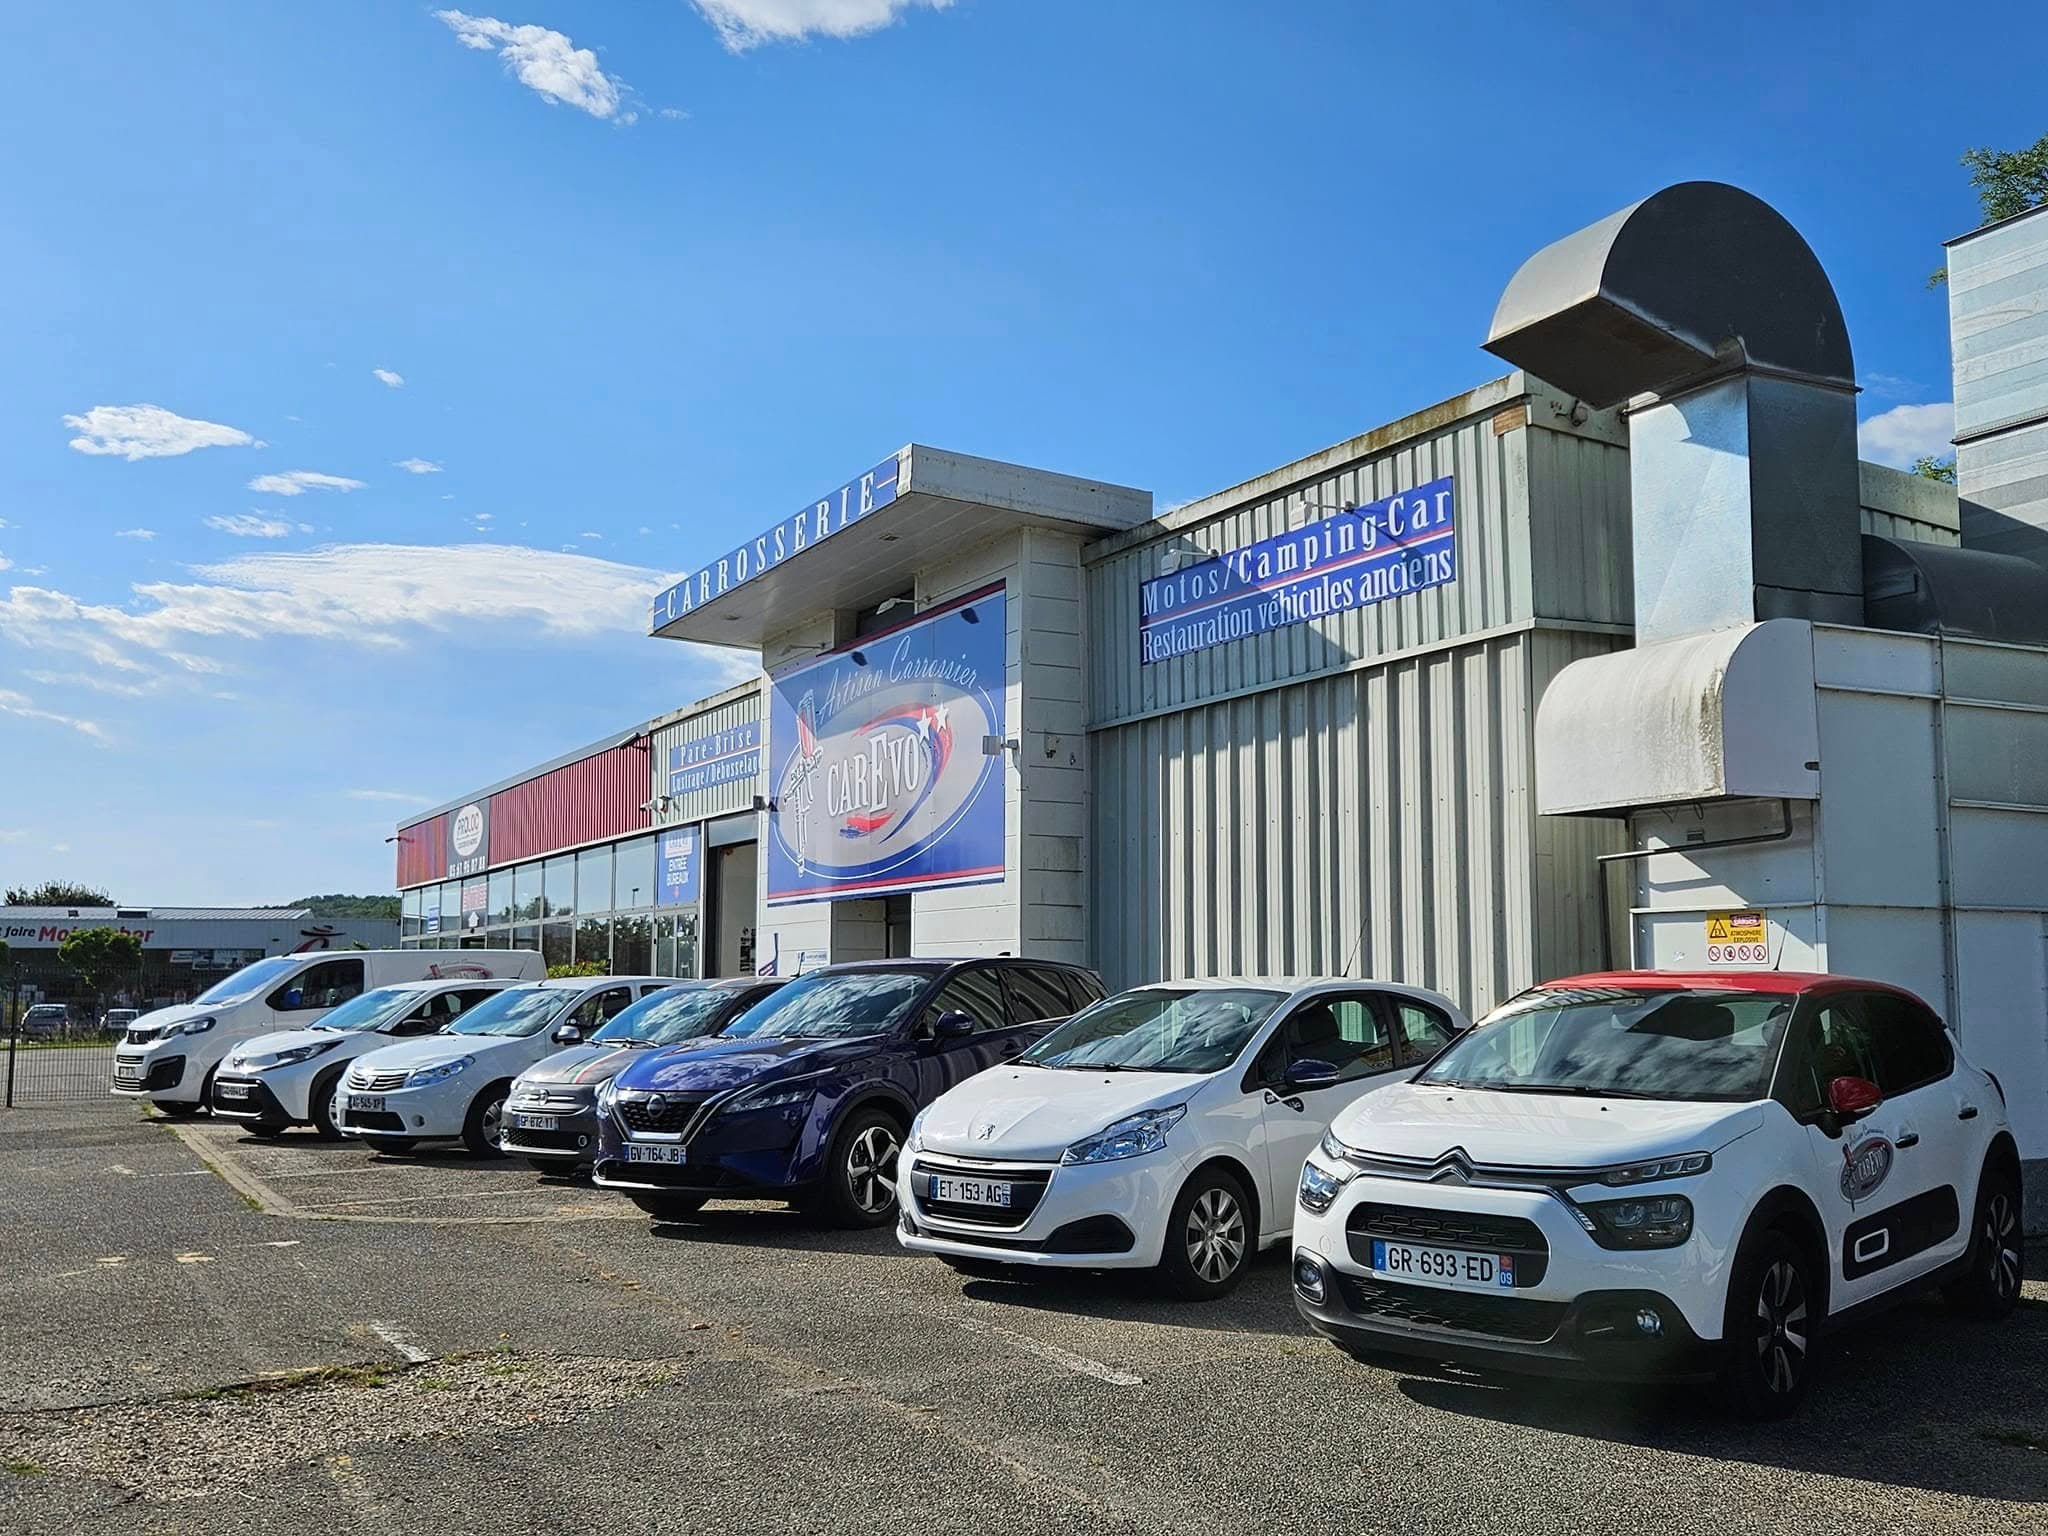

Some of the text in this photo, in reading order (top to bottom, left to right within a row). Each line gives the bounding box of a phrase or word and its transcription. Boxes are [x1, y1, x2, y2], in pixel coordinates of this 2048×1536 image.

[667, 472, 875, 619] CARROSSERIE
[1142, 491, 1450, 617] Motos/Camping-Car
[1143, 547, 1453, 663] Restauration véhicules anciens
[817, 635, 978, 727] Artisan Carrossier
[681, 729, 752, 766] Pare-Brise
[4, 926, 36, 938] faire
[630, 1146, 679, 1162] GV-764-JB
[939, 1180, 1002, 1203] ET-153-AG
[1388, 1247, 1493, 1282] GR-693-ED
[1500, 1272, 1512, 1285] 09
